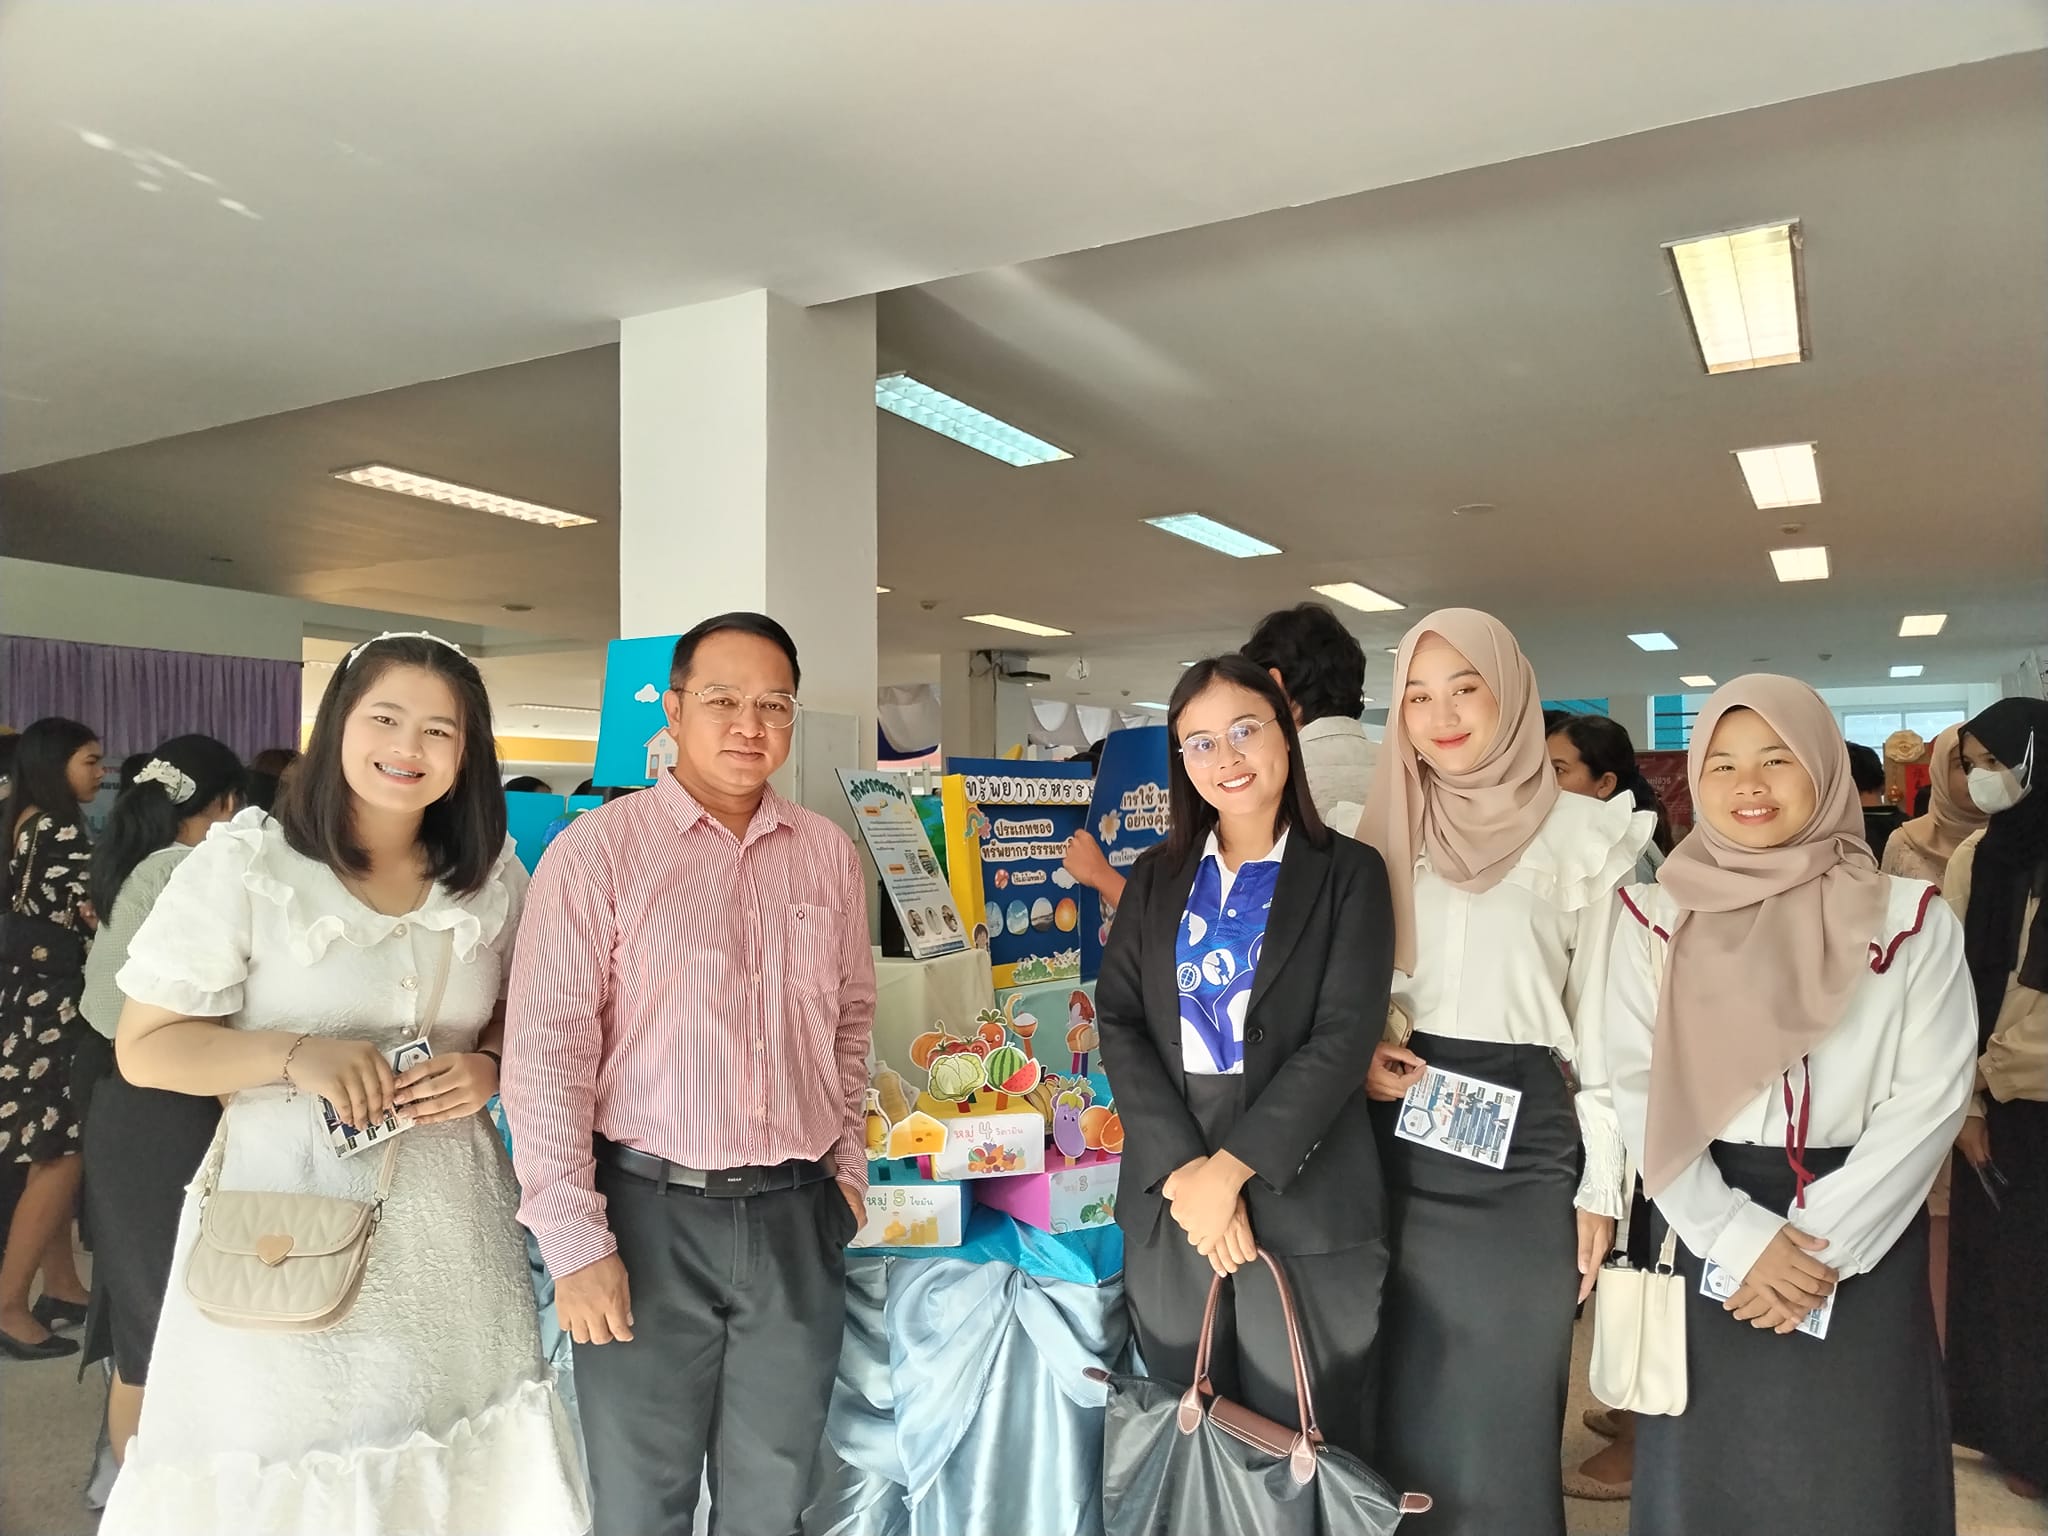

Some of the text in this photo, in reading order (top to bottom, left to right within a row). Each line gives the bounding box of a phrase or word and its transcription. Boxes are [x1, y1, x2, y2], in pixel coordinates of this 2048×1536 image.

[995, 822, 1052, 836] ประเภทของ
[979, 1121, 993, 1140] 4
[1079, 1175, 1089, 1192] 3
[866, 1192, 887, 1211] หมู่
